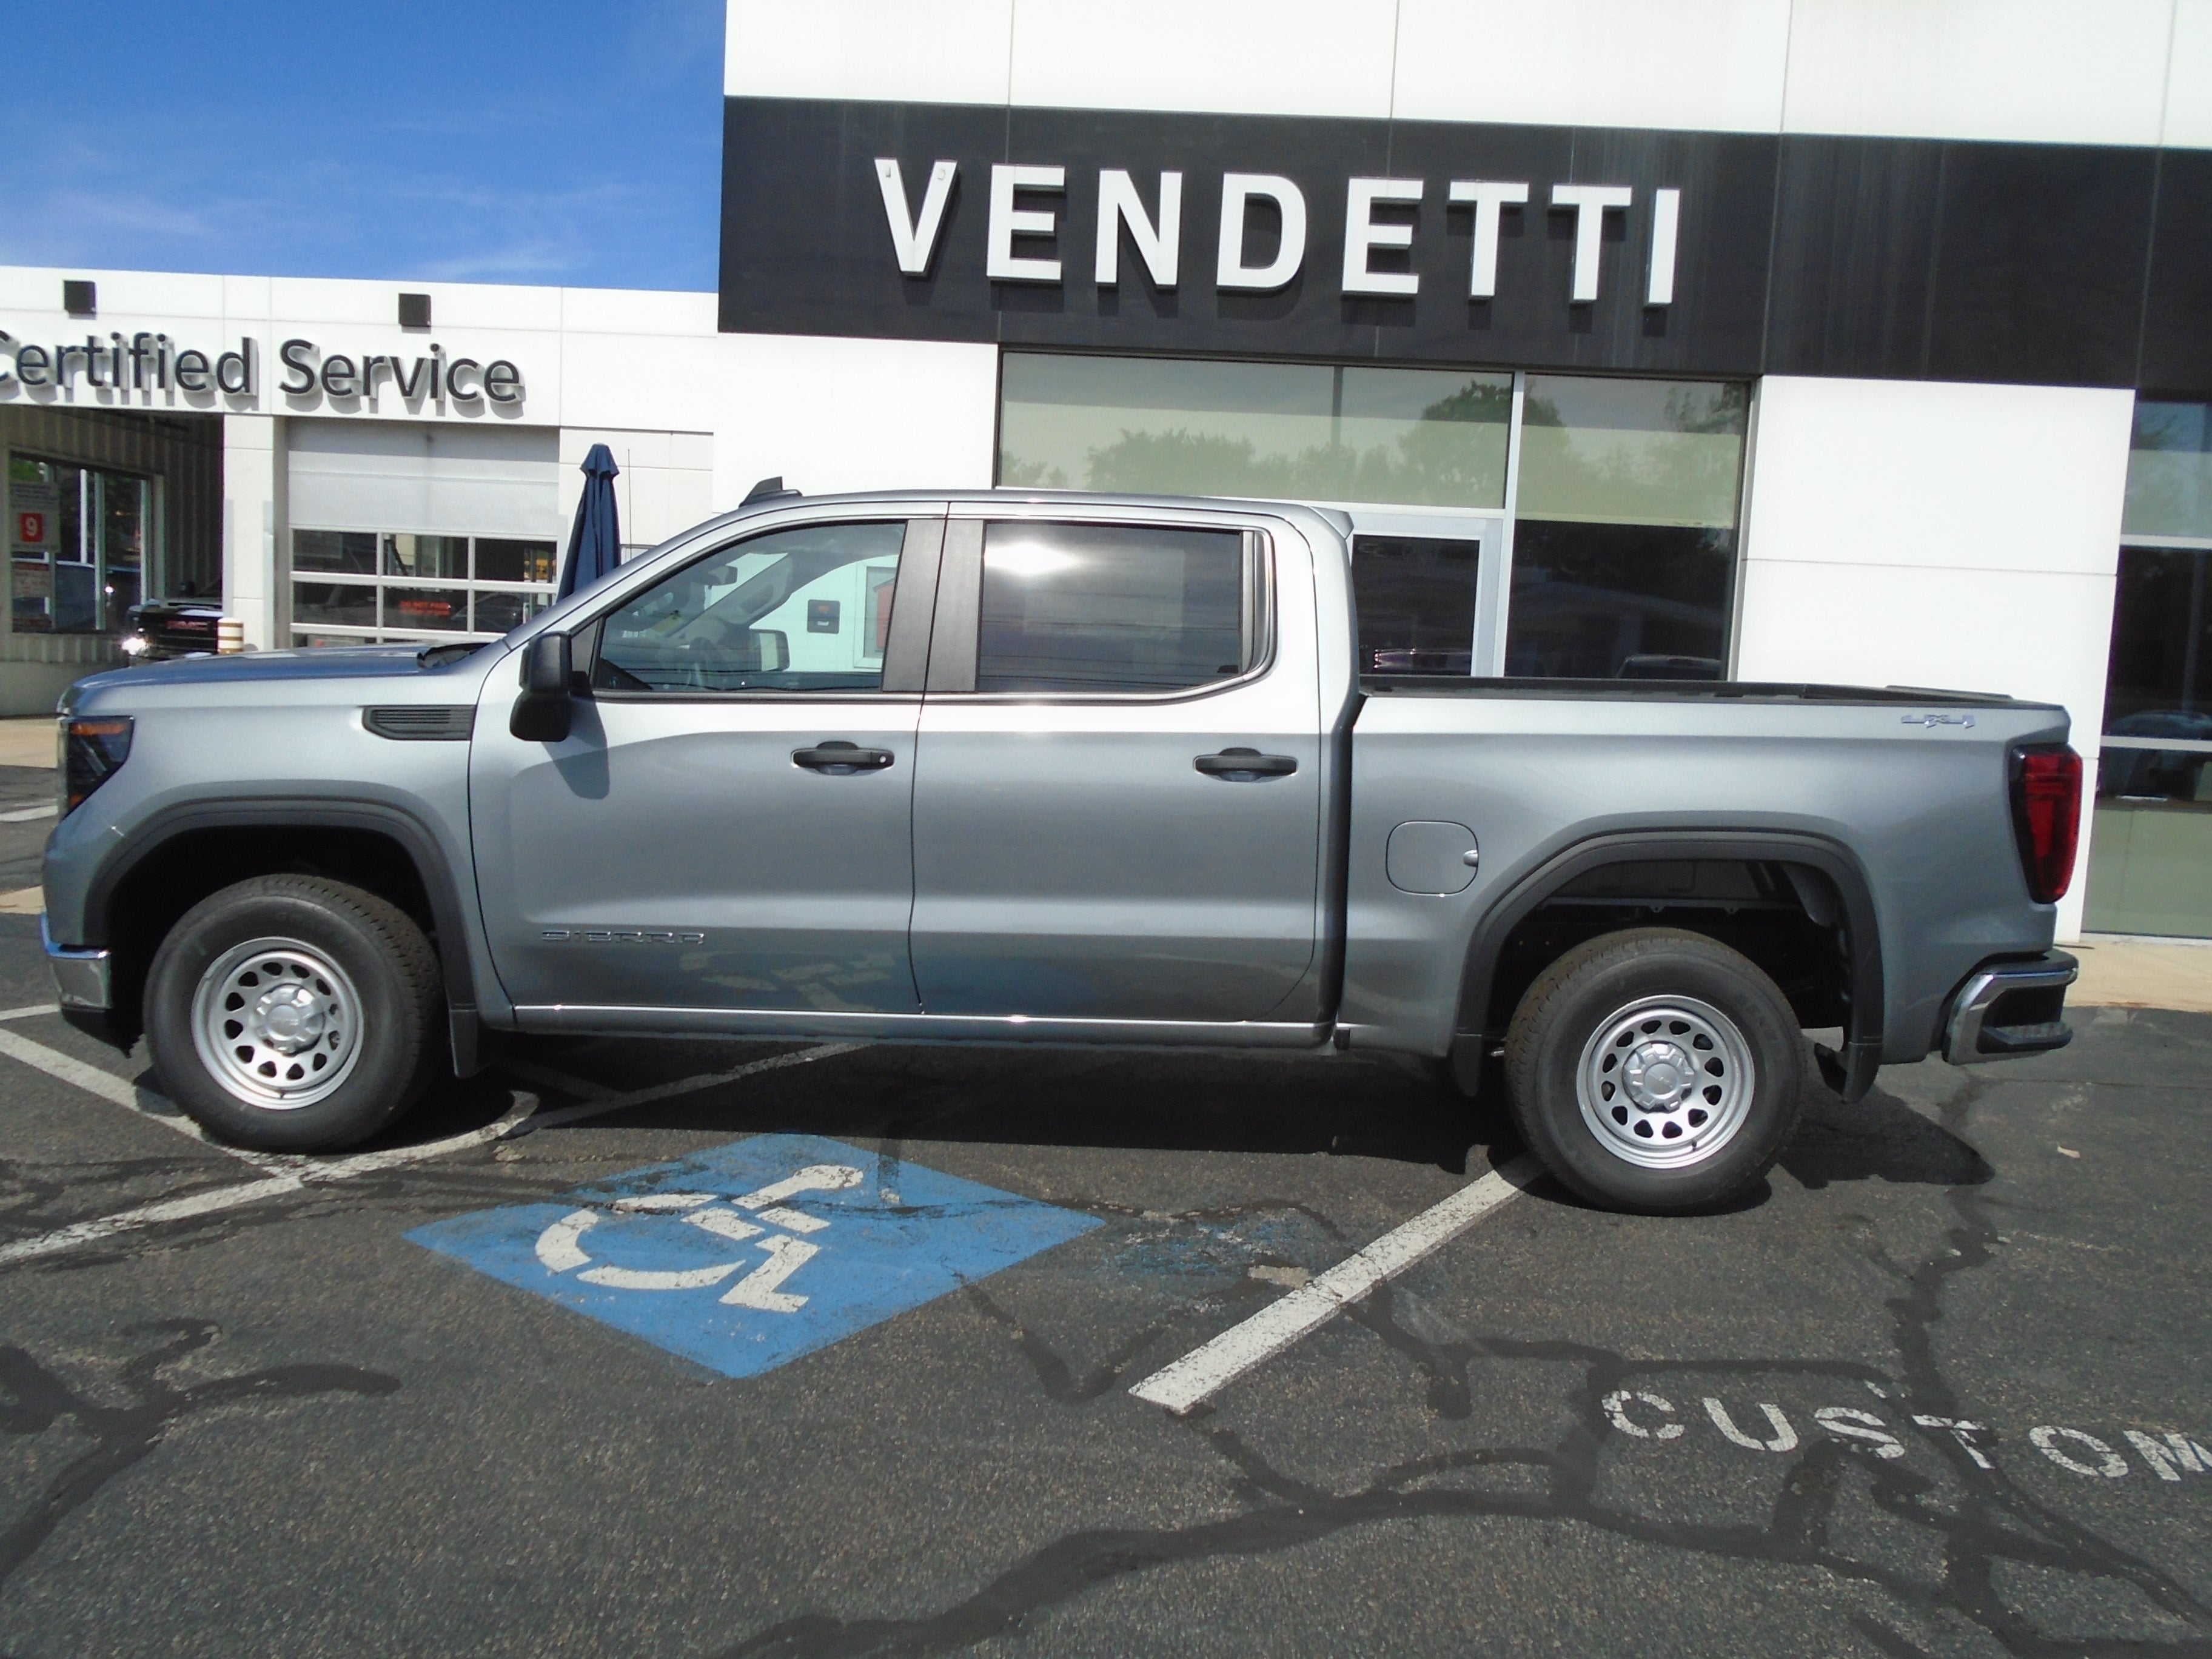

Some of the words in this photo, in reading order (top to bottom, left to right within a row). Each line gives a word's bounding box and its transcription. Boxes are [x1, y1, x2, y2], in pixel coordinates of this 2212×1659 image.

[874, 157, 1682, 307] VENDETTI
[278, 338, 521, 403] Service
[541, 930, 706, 945] SIERRA
[1601, 1389, 2212, 1482] CUSTOM
